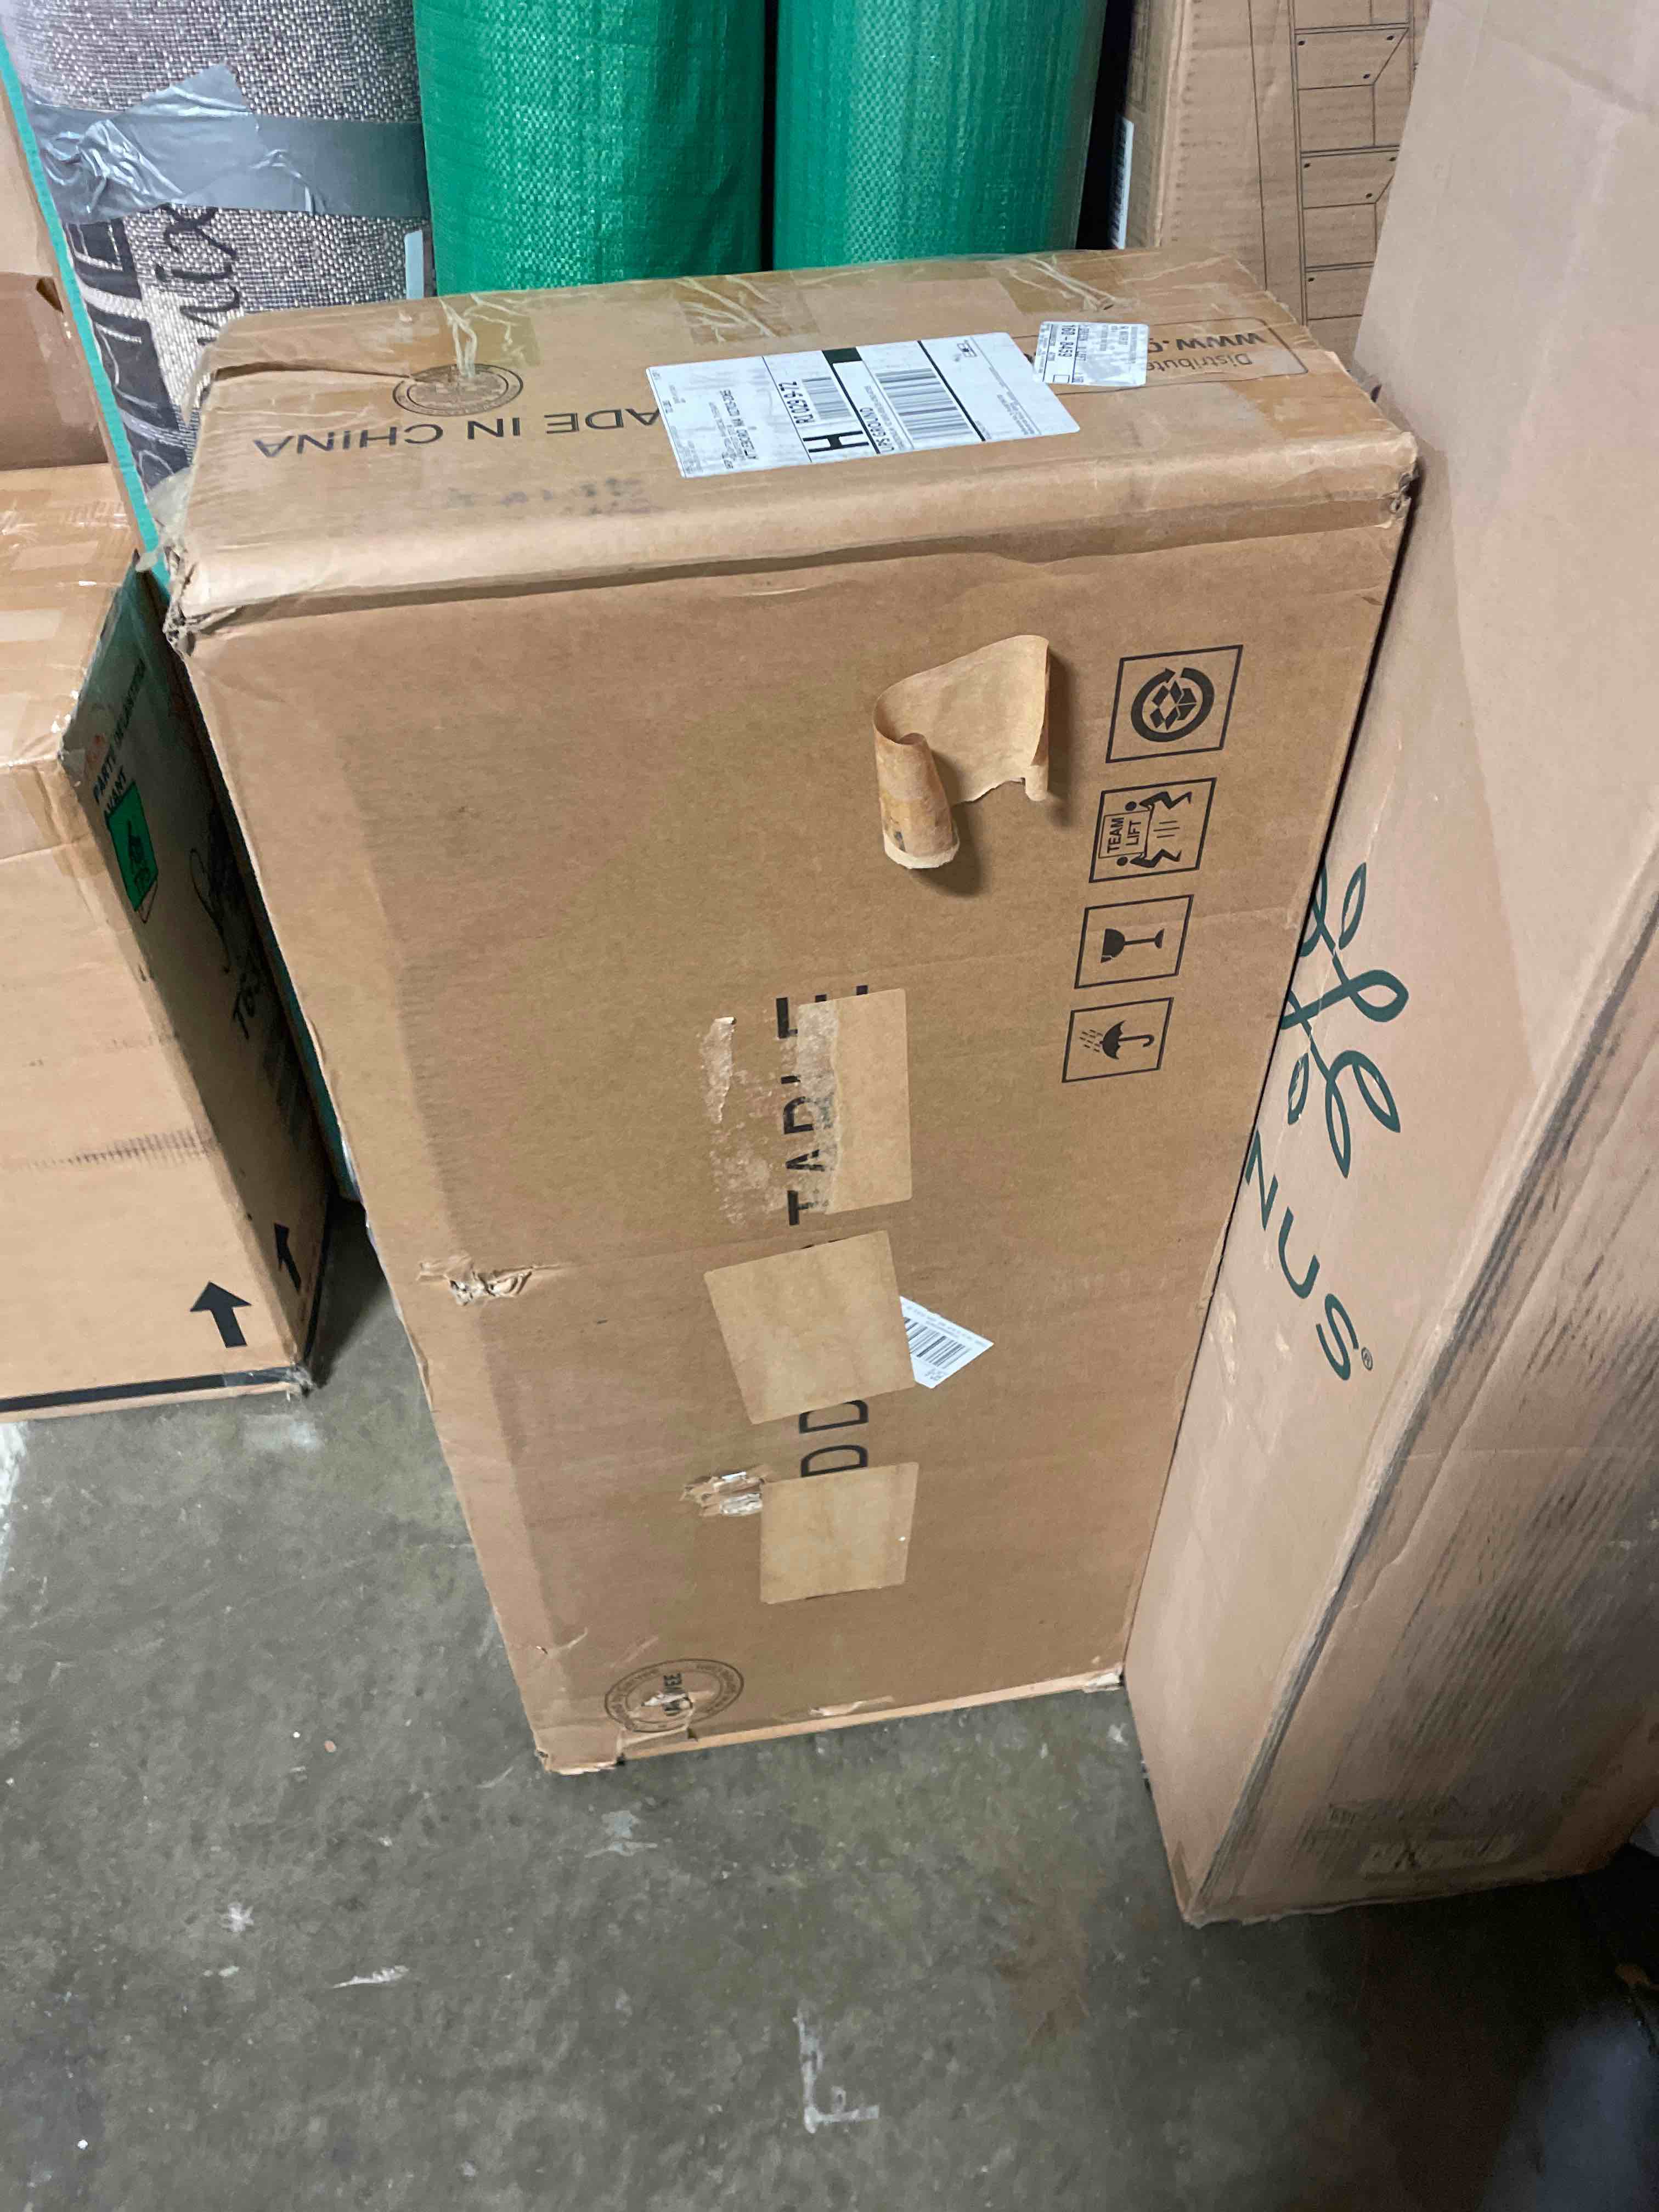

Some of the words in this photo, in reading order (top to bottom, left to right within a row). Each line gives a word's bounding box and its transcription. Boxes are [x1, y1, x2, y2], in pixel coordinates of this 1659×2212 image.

[1147, 353, 1252, 371] Distribute
[467, 417, 521, 439] IN
[544, 408, 660, 435] ADE
[253, 424, 444, 458] CHINA
[802, 430, 870, 453] H
[1107, 817, 1124, 854] TEAM
[1125, 820, 1142, 846] LIFT
[1245, 1129, 1359, 1381] NUS
